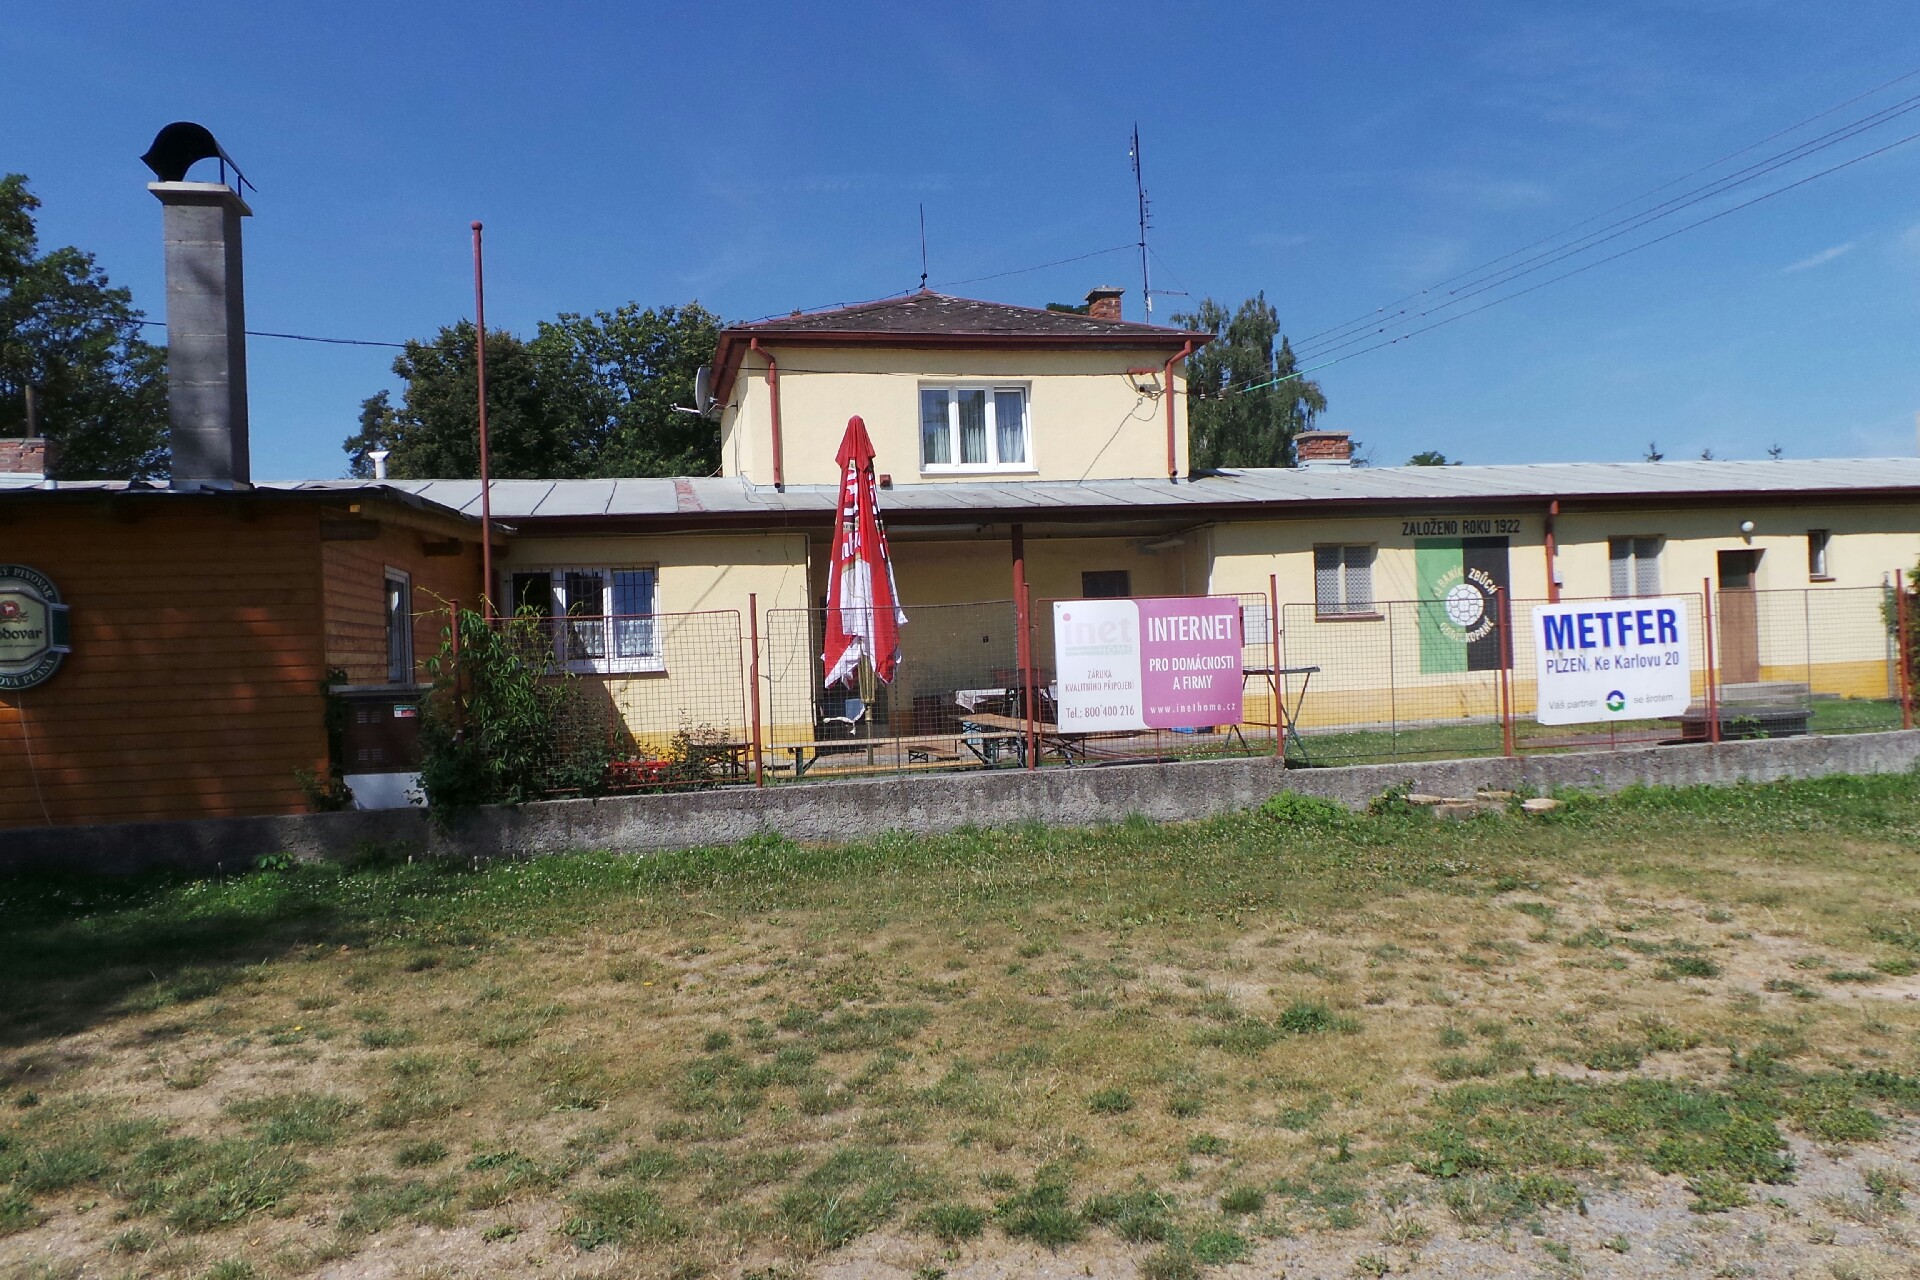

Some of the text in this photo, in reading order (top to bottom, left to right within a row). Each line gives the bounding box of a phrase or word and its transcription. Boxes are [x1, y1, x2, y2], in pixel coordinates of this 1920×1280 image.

[1402, 518, 1521, 536] ZALOŽENO ROKU 1922
[13, 567, 54, 598] PIVOVAR
[1062, 613, 1132, 645] inet
[1148, 614, 1234, 642] INTERNET
[1542, 608, 1678, 651] METFER
[1149, 653, 1234, 672] PRO DOMÁCNOSTI
[1546, 651, 1679, 674] PLZEŇ, Ke Karlovu 20
[1087, 668, 1112, 680] ZÁRUKA
[1065, 681, 1102, 693] KVALITNÍHO
[1173, 675, 1213, 690] A FIRMY
[1548, 699, 1598, 711] Vaš partner
[1633, 693, 1673, 704] se šrotem
[1065, 704, 1135, 719] Tel.: 800 400 216
[1150, 702, 1236, 714] www.inethome.cz
